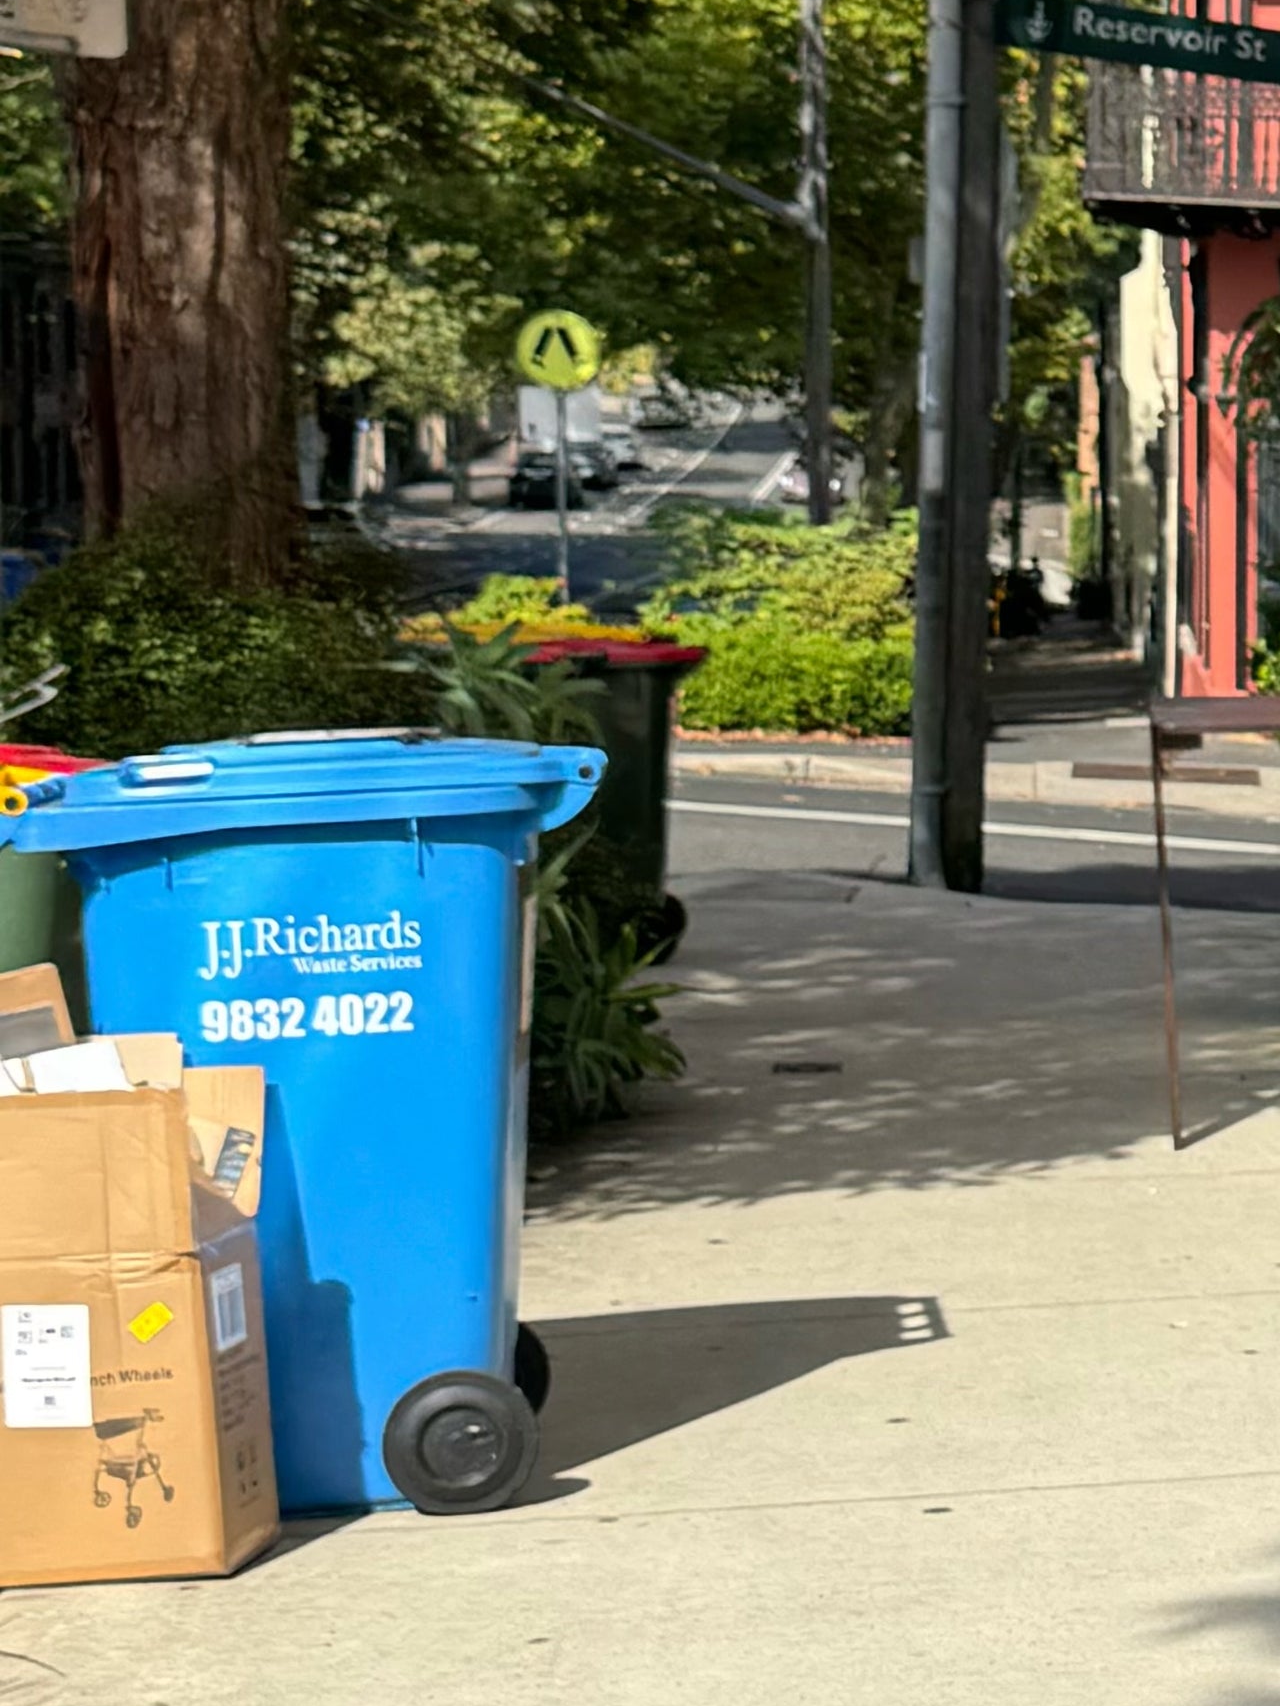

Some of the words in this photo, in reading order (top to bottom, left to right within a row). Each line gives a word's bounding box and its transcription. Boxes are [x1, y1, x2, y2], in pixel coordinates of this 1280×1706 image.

[1072, 4, 1226, 56] Reservoir
[1234, 30, 1267, 63] St
[292, 954, 349, 975] Waste
[349, 953, 424, 973] Services
[199, 996, 308, 1044] 9832
[311, 990, 415, 1037] 4022
[118, 1366, 175, 1386] Wheels
